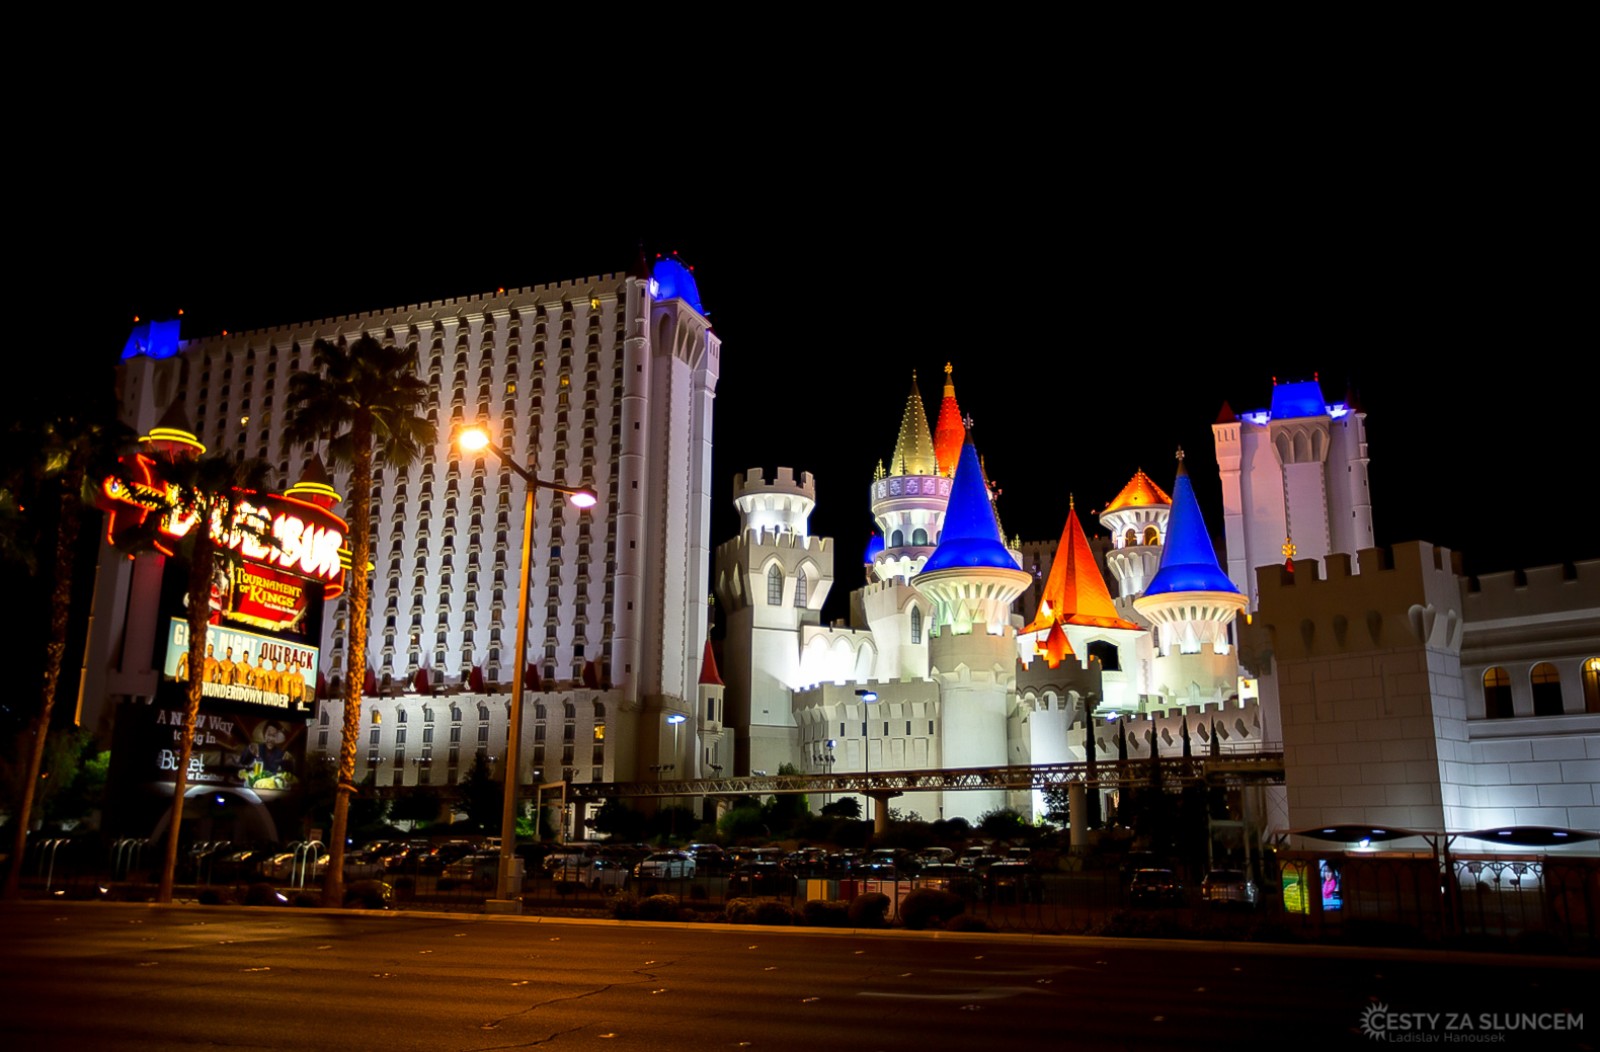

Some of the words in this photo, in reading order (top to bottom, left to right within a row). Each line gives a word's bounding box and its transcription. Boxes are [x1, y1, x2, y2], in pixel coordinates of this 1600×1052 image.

[236, 567, 302, 597] TOURNAMENT
[249, 584, 296, 608] KINGS
[174, 623, 215, 646] GIS
[219, 632, 258, 657] NIGHT
[261, 642, 314, 670] OUTBACK
[202, 681, 236, 700] HUNDER
[263, 690, 290, 708] UNDER
[156, 709, 167, 725] A
[170, 711, 207, 728] NW
[208, 715, 235, 736] Way
[160, 748, 205, 772] Buet
